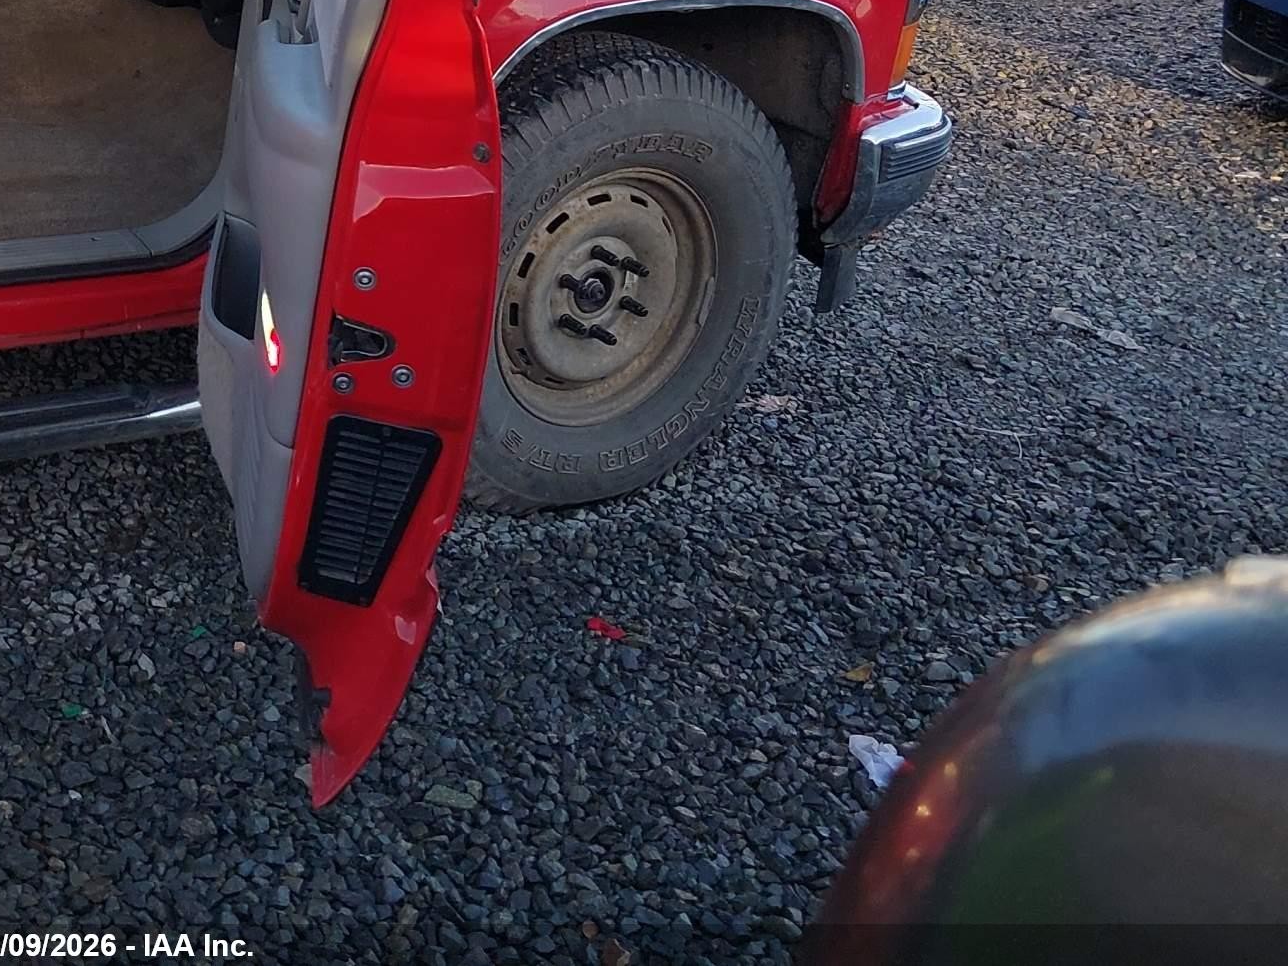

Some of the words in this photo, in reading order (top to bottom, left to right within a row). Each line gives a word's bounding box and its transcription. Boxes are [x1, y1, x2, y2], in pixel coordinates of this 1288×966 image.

[502, 132, 714, 259] GOODYEAR
[599, 295, 760, 472] WRANGLER
[501, 426, 582, 474] RT/S
